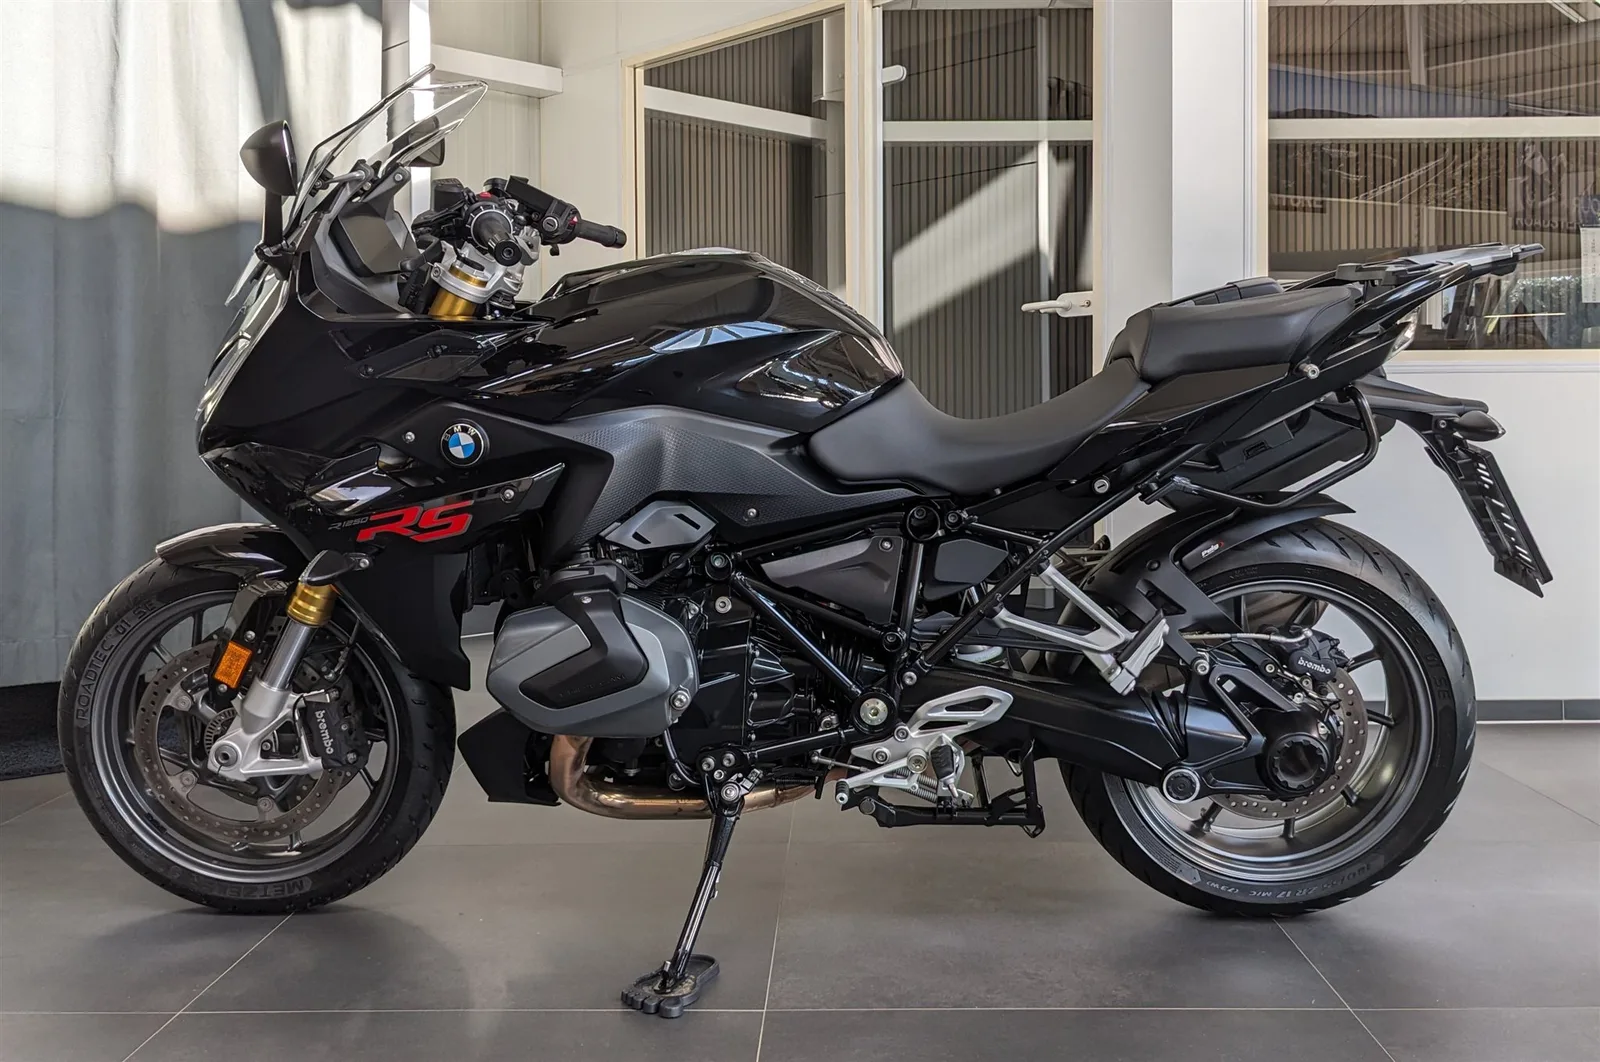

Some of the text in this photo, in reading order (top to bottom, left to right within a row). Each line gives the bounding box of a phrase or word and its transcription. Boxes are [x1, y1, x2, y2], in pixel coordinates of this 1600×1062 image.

[356, 500, 474, 542] RS
[76, 636, 115, 721] ROADTEC
[115, 619, 131, 635] 01
[1297, 656, 1332, 675] brembo
[315, 709, 334, 755] brembo
